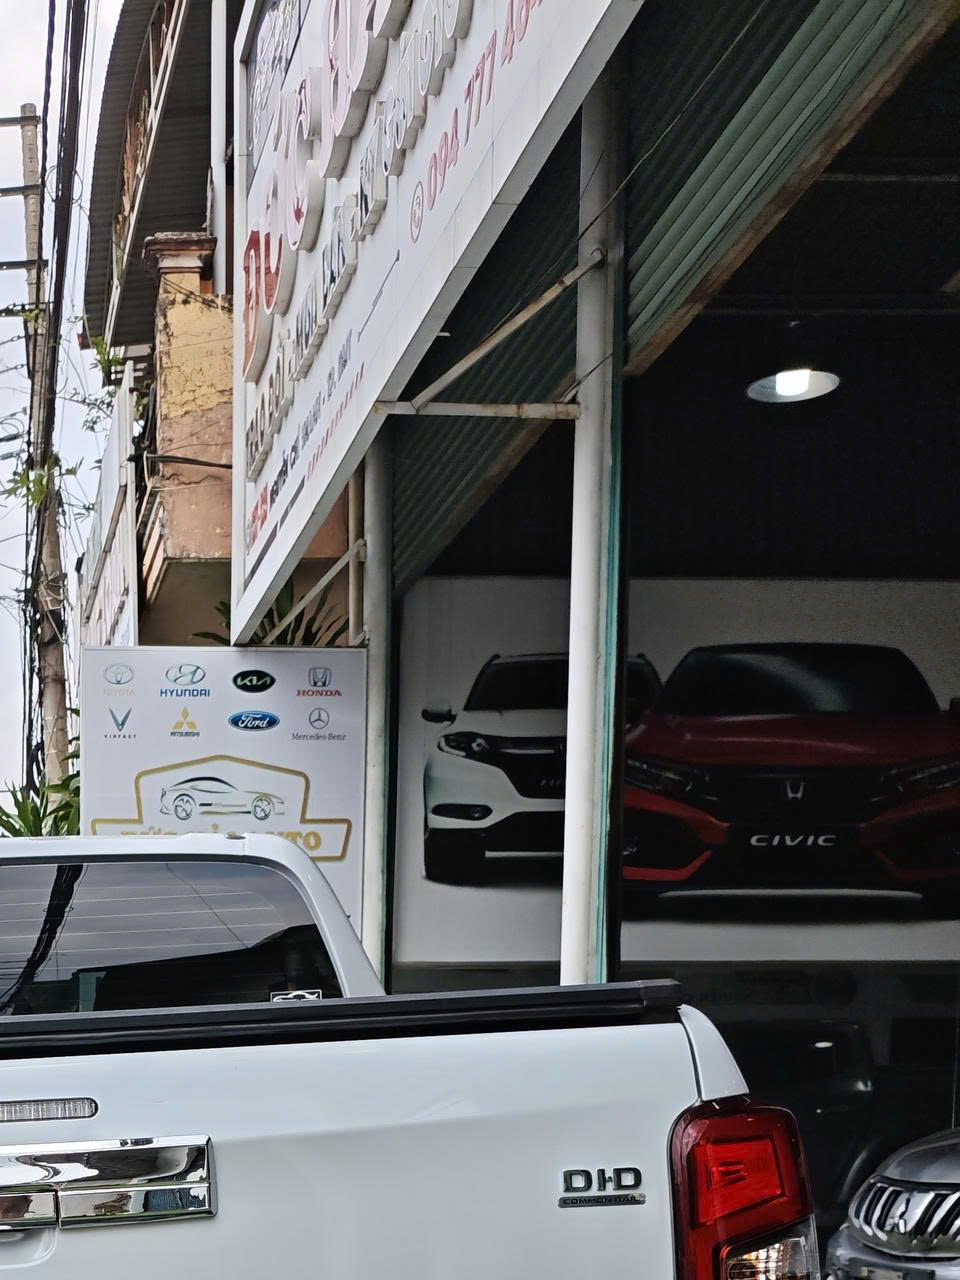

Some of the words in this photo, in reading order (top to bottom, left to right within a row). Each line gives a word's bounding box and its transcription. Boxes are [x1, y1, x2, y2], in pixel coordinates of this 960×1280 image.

[427, 107, 459, 210] 094
[464, 30, 496, 147] 777
[159, 688, 211, 698] HYUNDAI
[296, 689, 343, 697] HONDA
[238, 714, 270, 728] Ford
[291, 732, 347, 741] Mercedes-Benz
[750, 834, 837, 846] CIVIC
